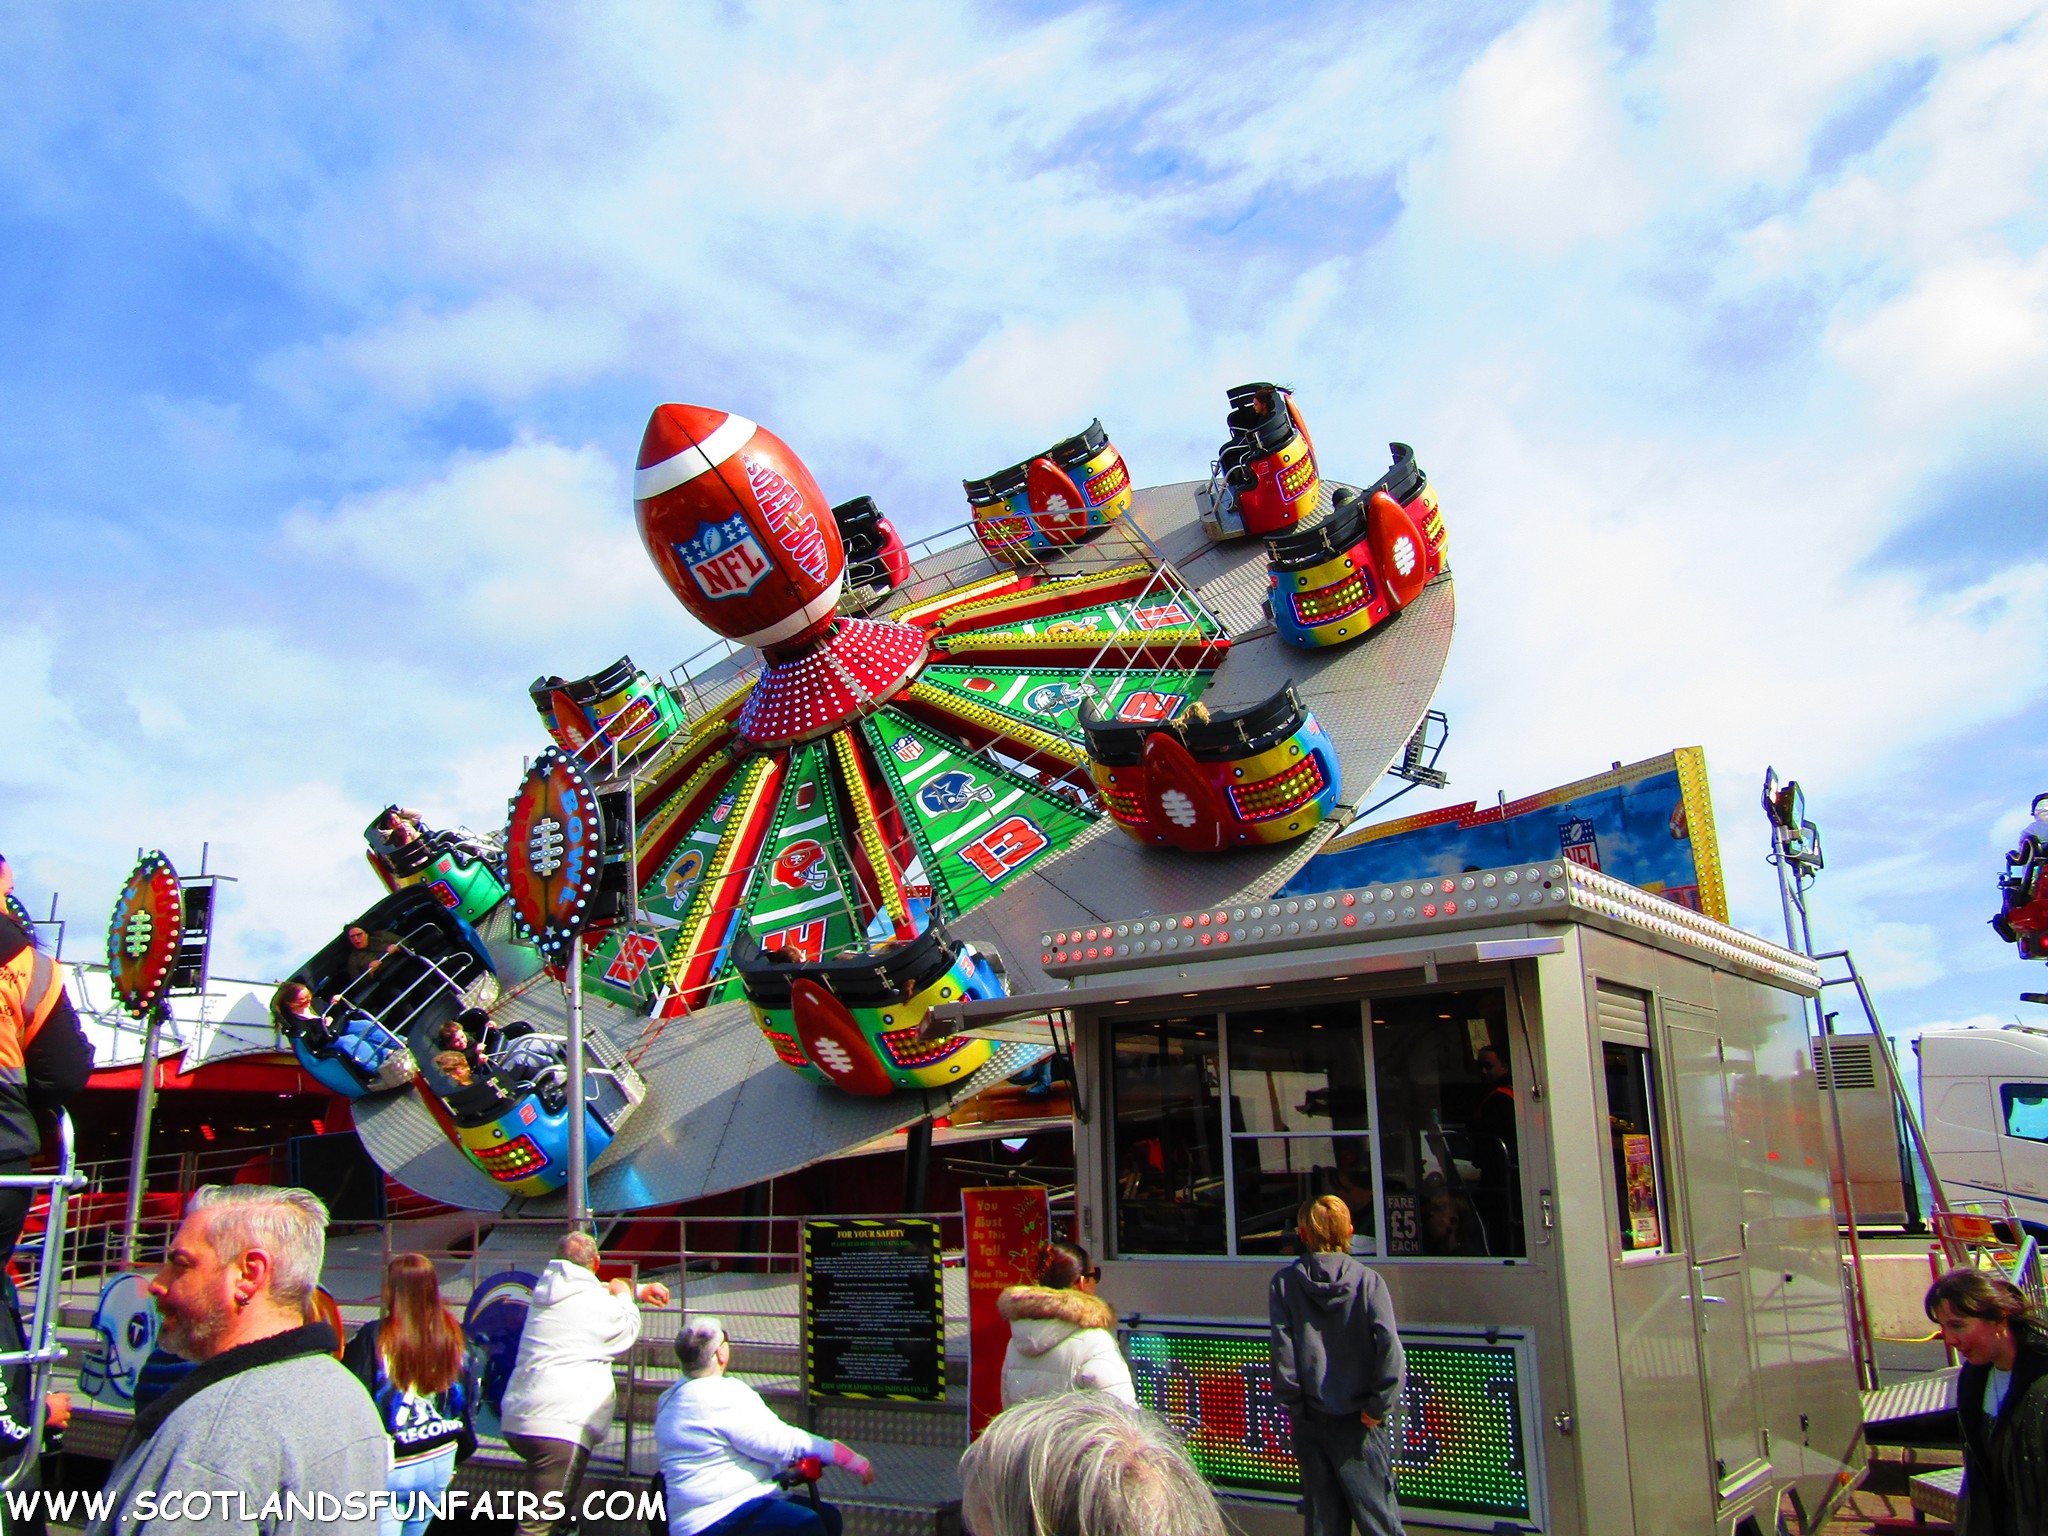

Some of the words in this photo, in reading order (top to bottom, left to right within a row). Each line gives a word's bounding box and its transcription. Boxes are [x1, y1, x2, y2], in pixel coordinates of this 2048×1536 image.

[746, 462, 804, 534] SUPER
[779, 513, 829, 583] BOWL
[695, 543, 765, 596] NFL
[898, 742, 923, 761] NFL
[559, 788, 584, 904] BOWL
[959, 816, 1049, 882] 13
[1564, 844, 1601, 873] NFL
[518, 1103, 538, 1126] 2
[977, 1199, 998, 1211] You
[1387, 1197, 1415, 1209] FARE
[974, 1215, 1002, 1228] Must
[1390, 1210, 1417, 1239] £5
[837, 1230, 853, 1239] FOR
[854, 1230, 875, 1238] YOUR
[876, 1229, 906, 1238] SAFETY
[988, 1230, 1006, 1240] This
[979, 1243, 1000, 1256] Tall
[1391, 1240, 1419, 1252] EACH
